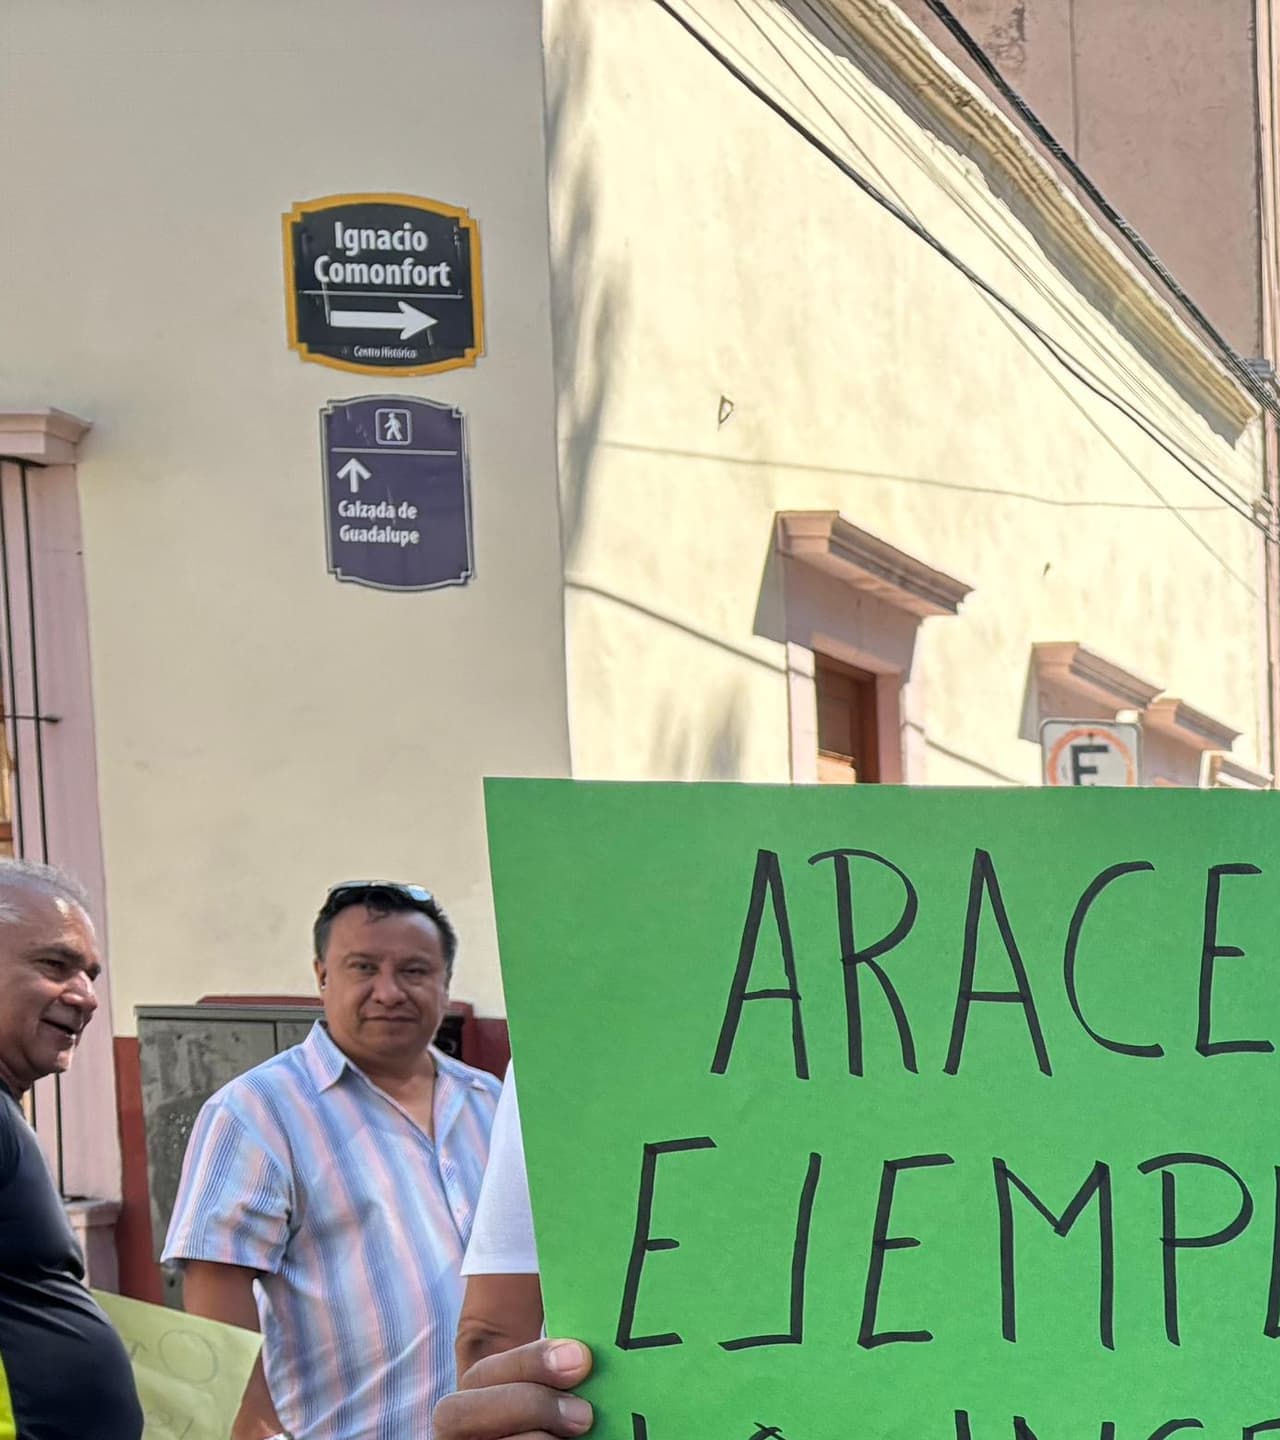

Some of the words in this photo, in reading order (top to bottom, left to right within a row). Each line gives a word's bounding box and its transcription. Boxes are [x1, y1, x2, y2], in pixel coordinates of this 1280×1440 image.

[334, 221, 428, 256] Ignacio
[314, 255, 451, 287] Comonfort
[353, 345, 381, 359] Centro
[338, 501, 396, 522] Calzada
[398, 504, 418, 520] de
[340, 524, 420, 547] Guadalupe
